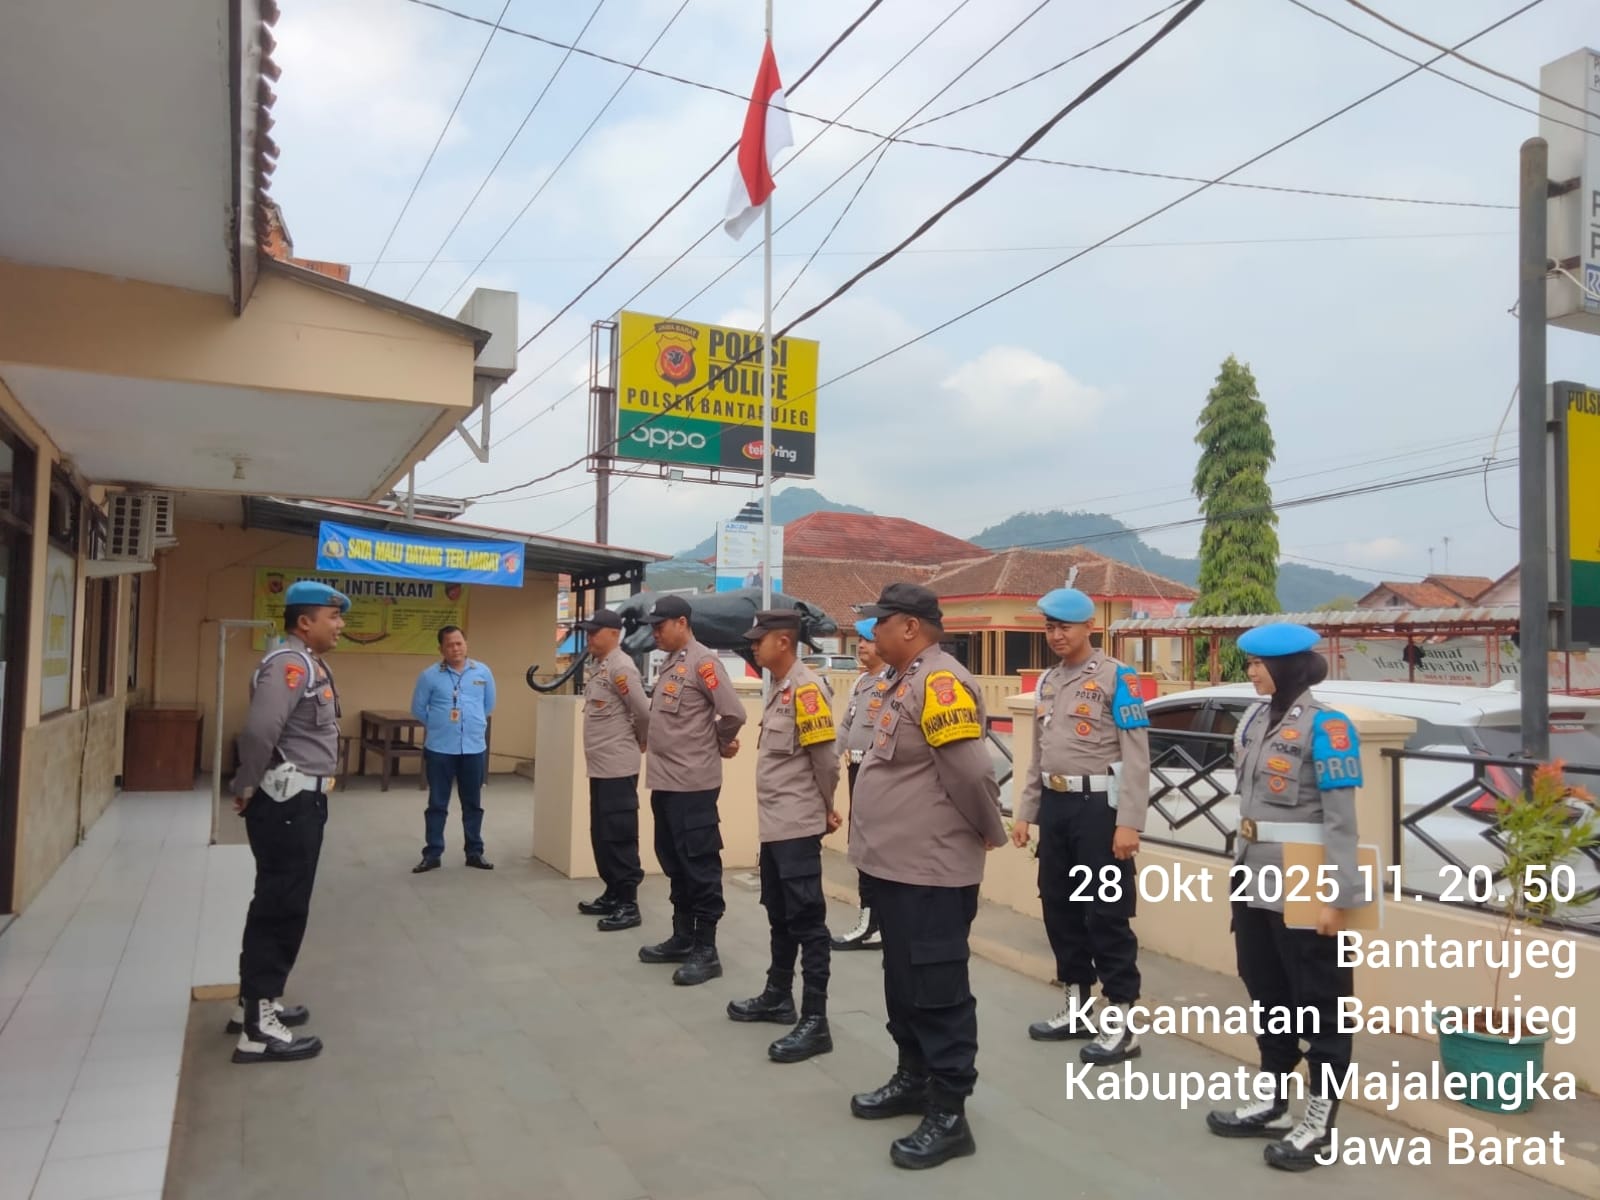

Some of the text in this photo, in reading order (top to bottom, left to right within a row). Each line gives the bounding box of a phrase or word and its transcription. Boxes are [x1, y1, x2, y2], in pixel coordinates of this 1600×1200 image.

[627, 387, 695, 412] POLSEK
[348, 537, 500, 572] SAYA MALU DATANG TERLAMBAT
[345, 579, 433, 598] INTELKAM
[1075, 690, 1101, 701] POLRI
[1271, 741, 1301, 756] POLRI
